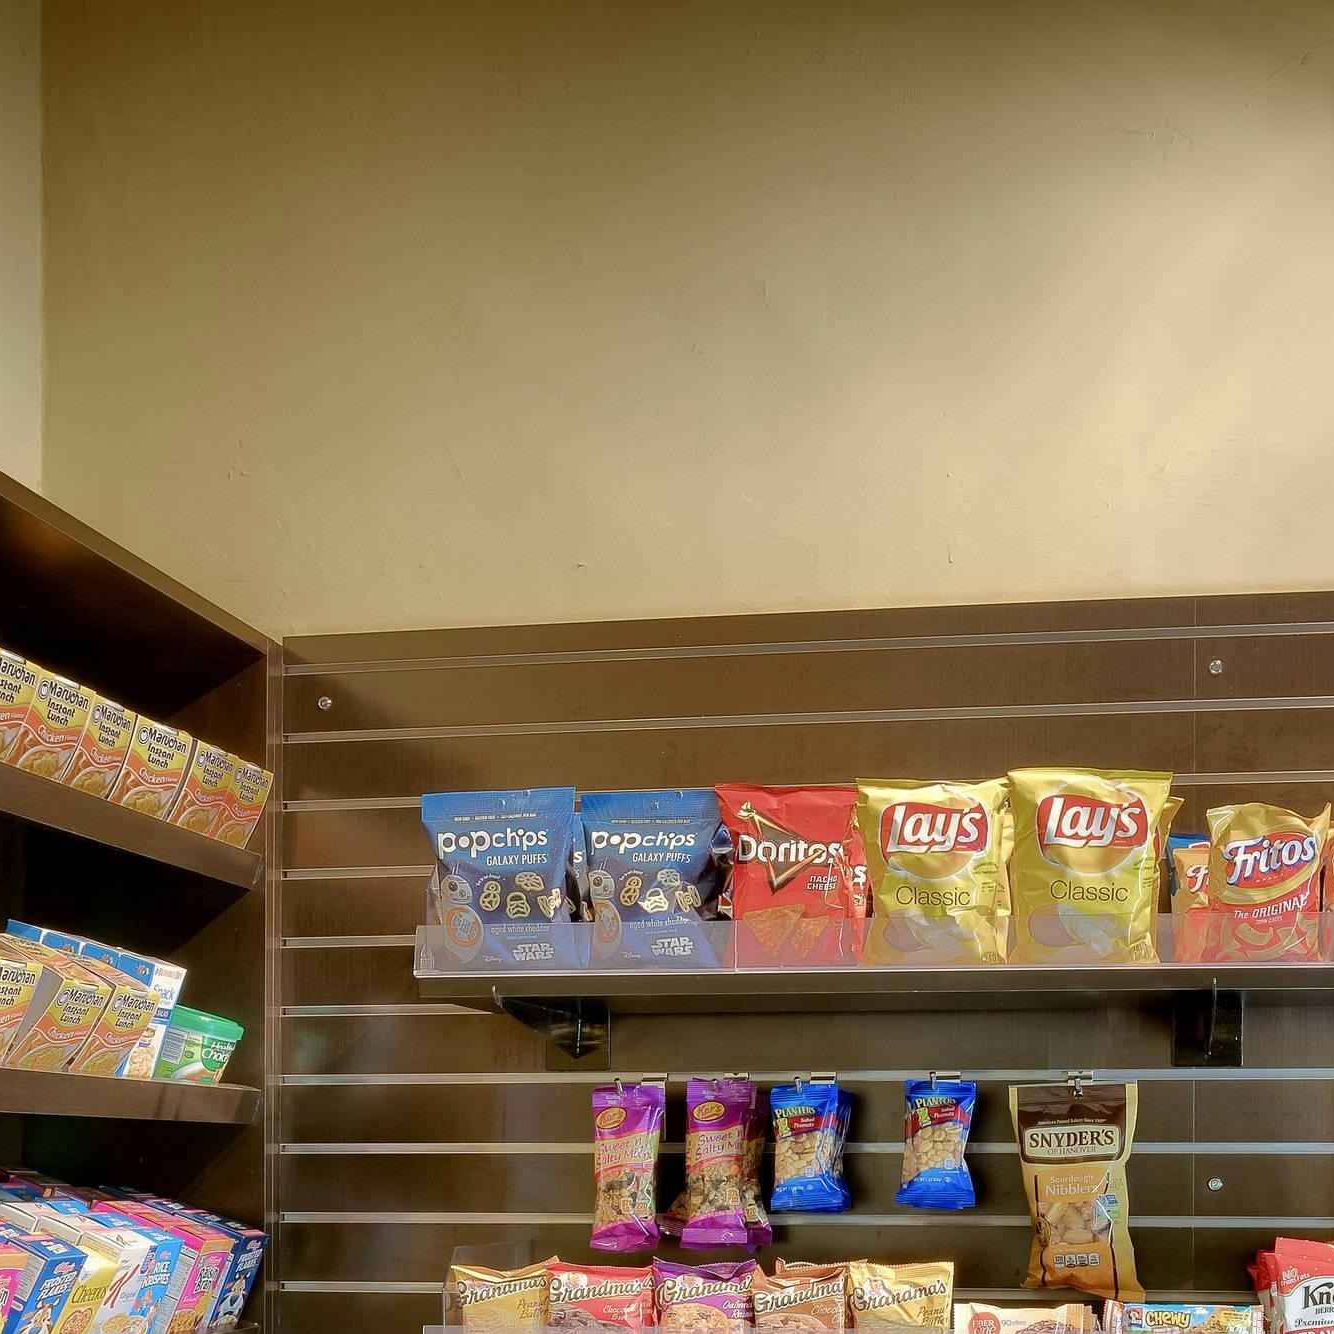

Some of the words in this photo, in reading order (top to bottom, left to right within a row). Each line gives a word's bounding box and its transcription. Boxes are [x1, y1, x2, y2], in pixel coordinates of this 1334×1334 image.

[50, 680, 89, 710] Maruchan
[47, 698, 76, 718] Instant
[47, 710, 69, 726] Lunch
[100, 704, 131, 732] Maruchan
[99, 722, 121, 739] Instant
[148, 726, 187, 755] Maruchan
[147, 743, 175, 762] Instant
[148, 754, 169, 769] Lunch
[885, 804, 988, 854] Lay's
[1043, 797, 1140, 850] Lay's
[437, 827, 548, 859] popchips
[590, 831, 697, 858] popchips
[738, 834, 845, 865] Doritos
[486, 855, 519, 867] GALAXY
[521, 853, 548, 865] PUFFS
[632, 852, 665, 863] GALAXY
[666, 853, 691, 864] PUFFS
[1227, 832, 1316, 886] Fritos
[806, 882, 838, 891] CHEESE
[809, 875, 839, 884] NACHO
[894, 884, 972, 907] Classic
[1049, 879, 1129, 902] Classic
[1251, 898, 1308, 919] ORIGINAL
[513, 942, 554, 953] STAR
[652, 937, 693, 949] STAR
[66, 989, 104, 1007] Maruchan
[121, 993, 155, 1013] Maruchan
[63, 1005, 90, 1018] Instant
[117, 1008, 143, 1022] Instant
[697, 1104, 722, 1118] Kar's
[774, 1105, 816, 1119] PLANTERS
[698, 1132, 732, 1147] Sweet
[1029, 1129, 1115, 1149] SNYDER'S
[599, 1140, 630, 1156] Sweet
[695, 1144, 725, 1160] Salty
[1058, 1145, 1097, 1155] HANOVER
[596, 1152, 621, 1169] Salty
[1050, 1173, 1094, 1184] Sourdough
[1045, 1182, 1099, 1196] Nibblers
[154, 1260, 170, 1275] RICE
[41, 1272, 78, 1291] FROSTED
[103, 1264, 140, 1309] K
[36, 1283, 69, 1301] FLAKES
[548, 1277, 642, 1304] Grandma's
[853, 1279, 947, 1313] Grandma's
[972, 1319, 995, 1327] FIBER
[1145, 1310, 1191, 1327] CHEWY
